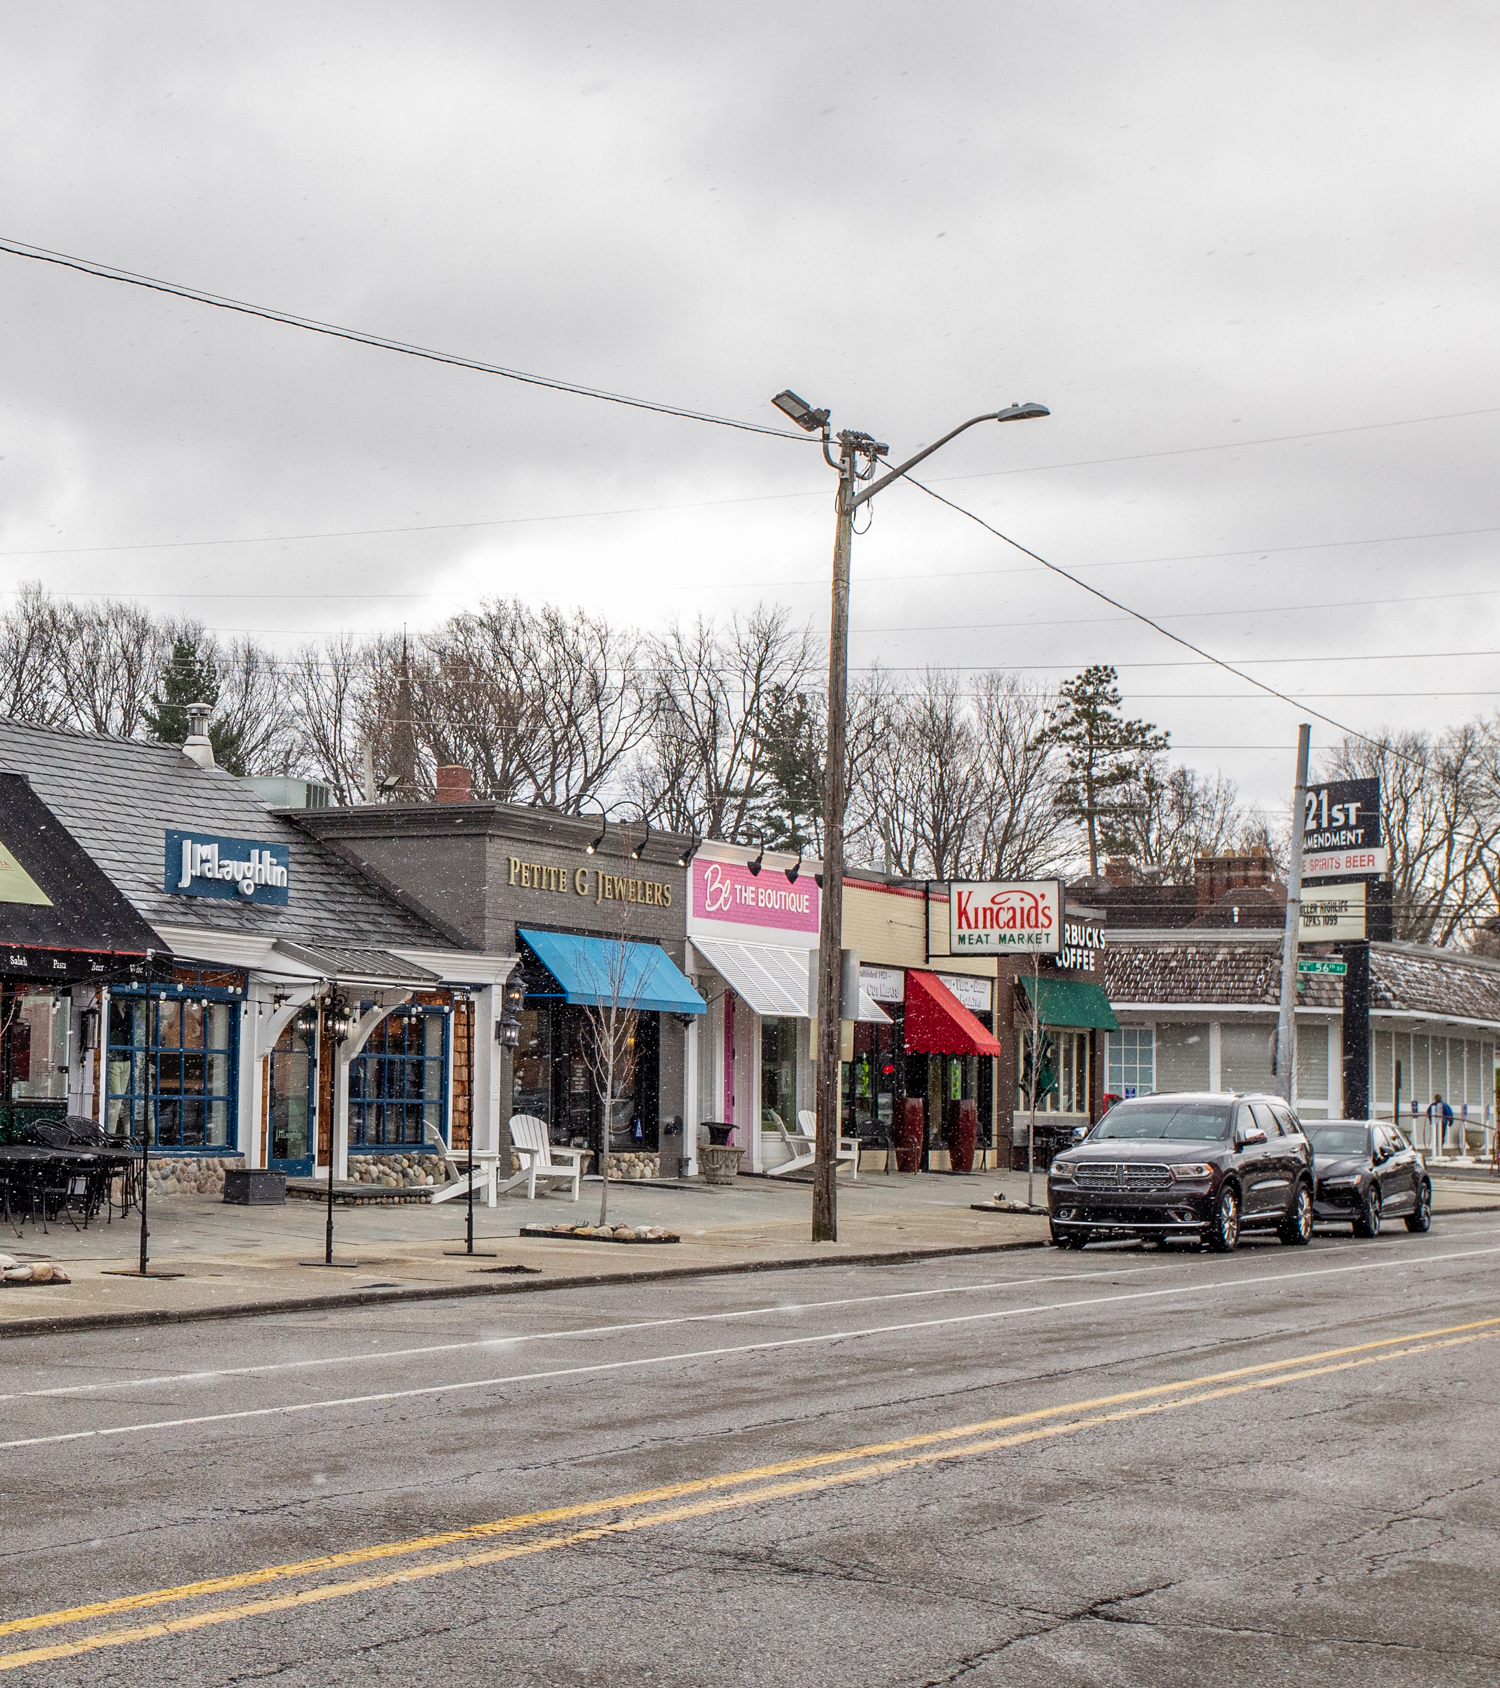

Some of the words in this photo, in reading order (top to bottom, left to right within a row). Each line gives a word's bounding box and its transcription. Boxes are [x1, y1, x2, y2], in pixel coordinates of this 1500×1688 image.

[1305, 789, 1362, 831] 21ST
[1303, 829, 1365, 850] AMENDMENT
[1309, 856, 1342, 872] SPIRITS
[1345, 854, 1376, 869] BEER
[507, 856, 568, 893] PETITE
[575, 867, 590, 896] G
[595, 869, 673, 908] JEWELERS
[704, 863, 733, 912] Be
[734, 884, 756, 906] THE
[757, 888, 810, 914] BOUTIQUE
[956, 890, 1053, 931] Kincaid's
[958, 933, 991, 946] MEAT
[999, 932, 1052, 946] MARKET
[1064, 923, 1106, 950] RBUCKS
